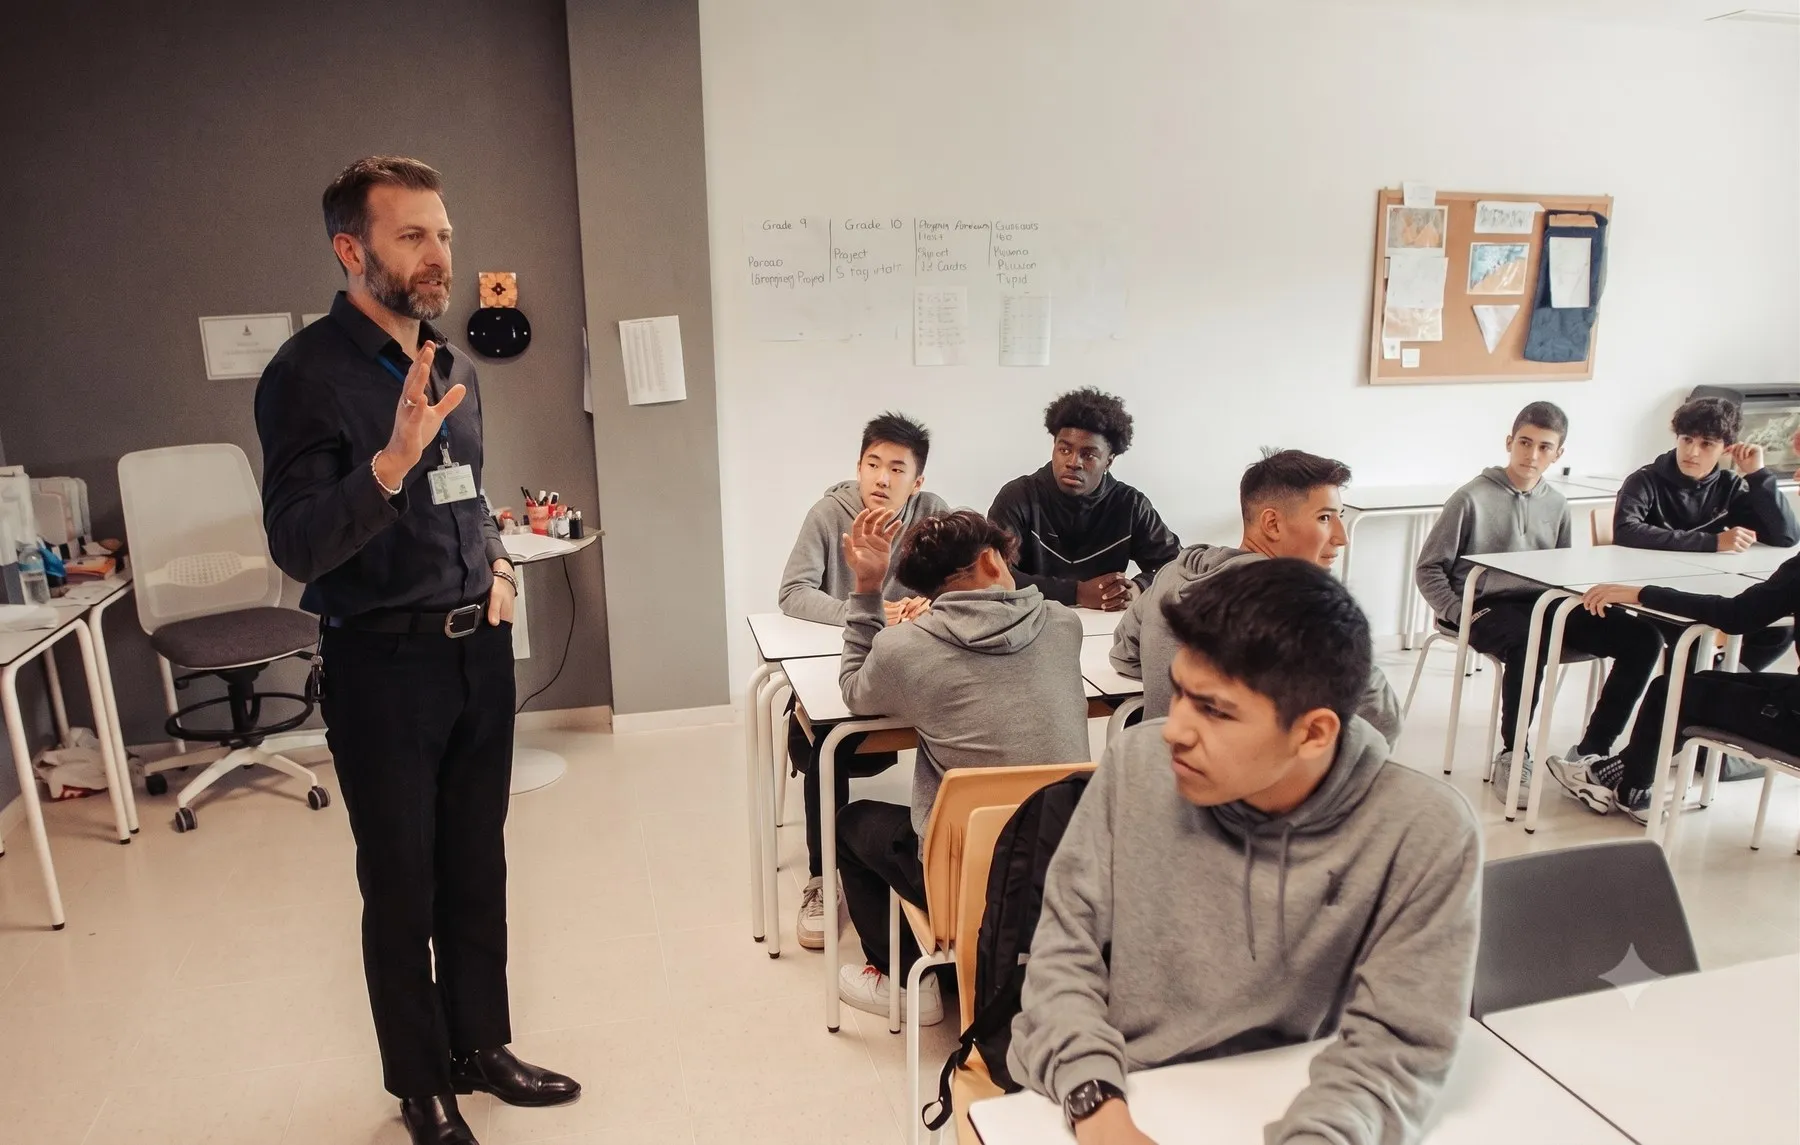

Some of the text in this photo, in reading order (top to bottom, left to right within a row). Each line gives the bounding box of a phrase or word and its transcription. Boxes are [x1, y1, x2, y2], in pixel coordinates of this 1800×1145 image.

[762, 217, 808, 231] Grade 9
[844, 218, 903, 231] Grade 10
[833, 247, 868, 264] Project
